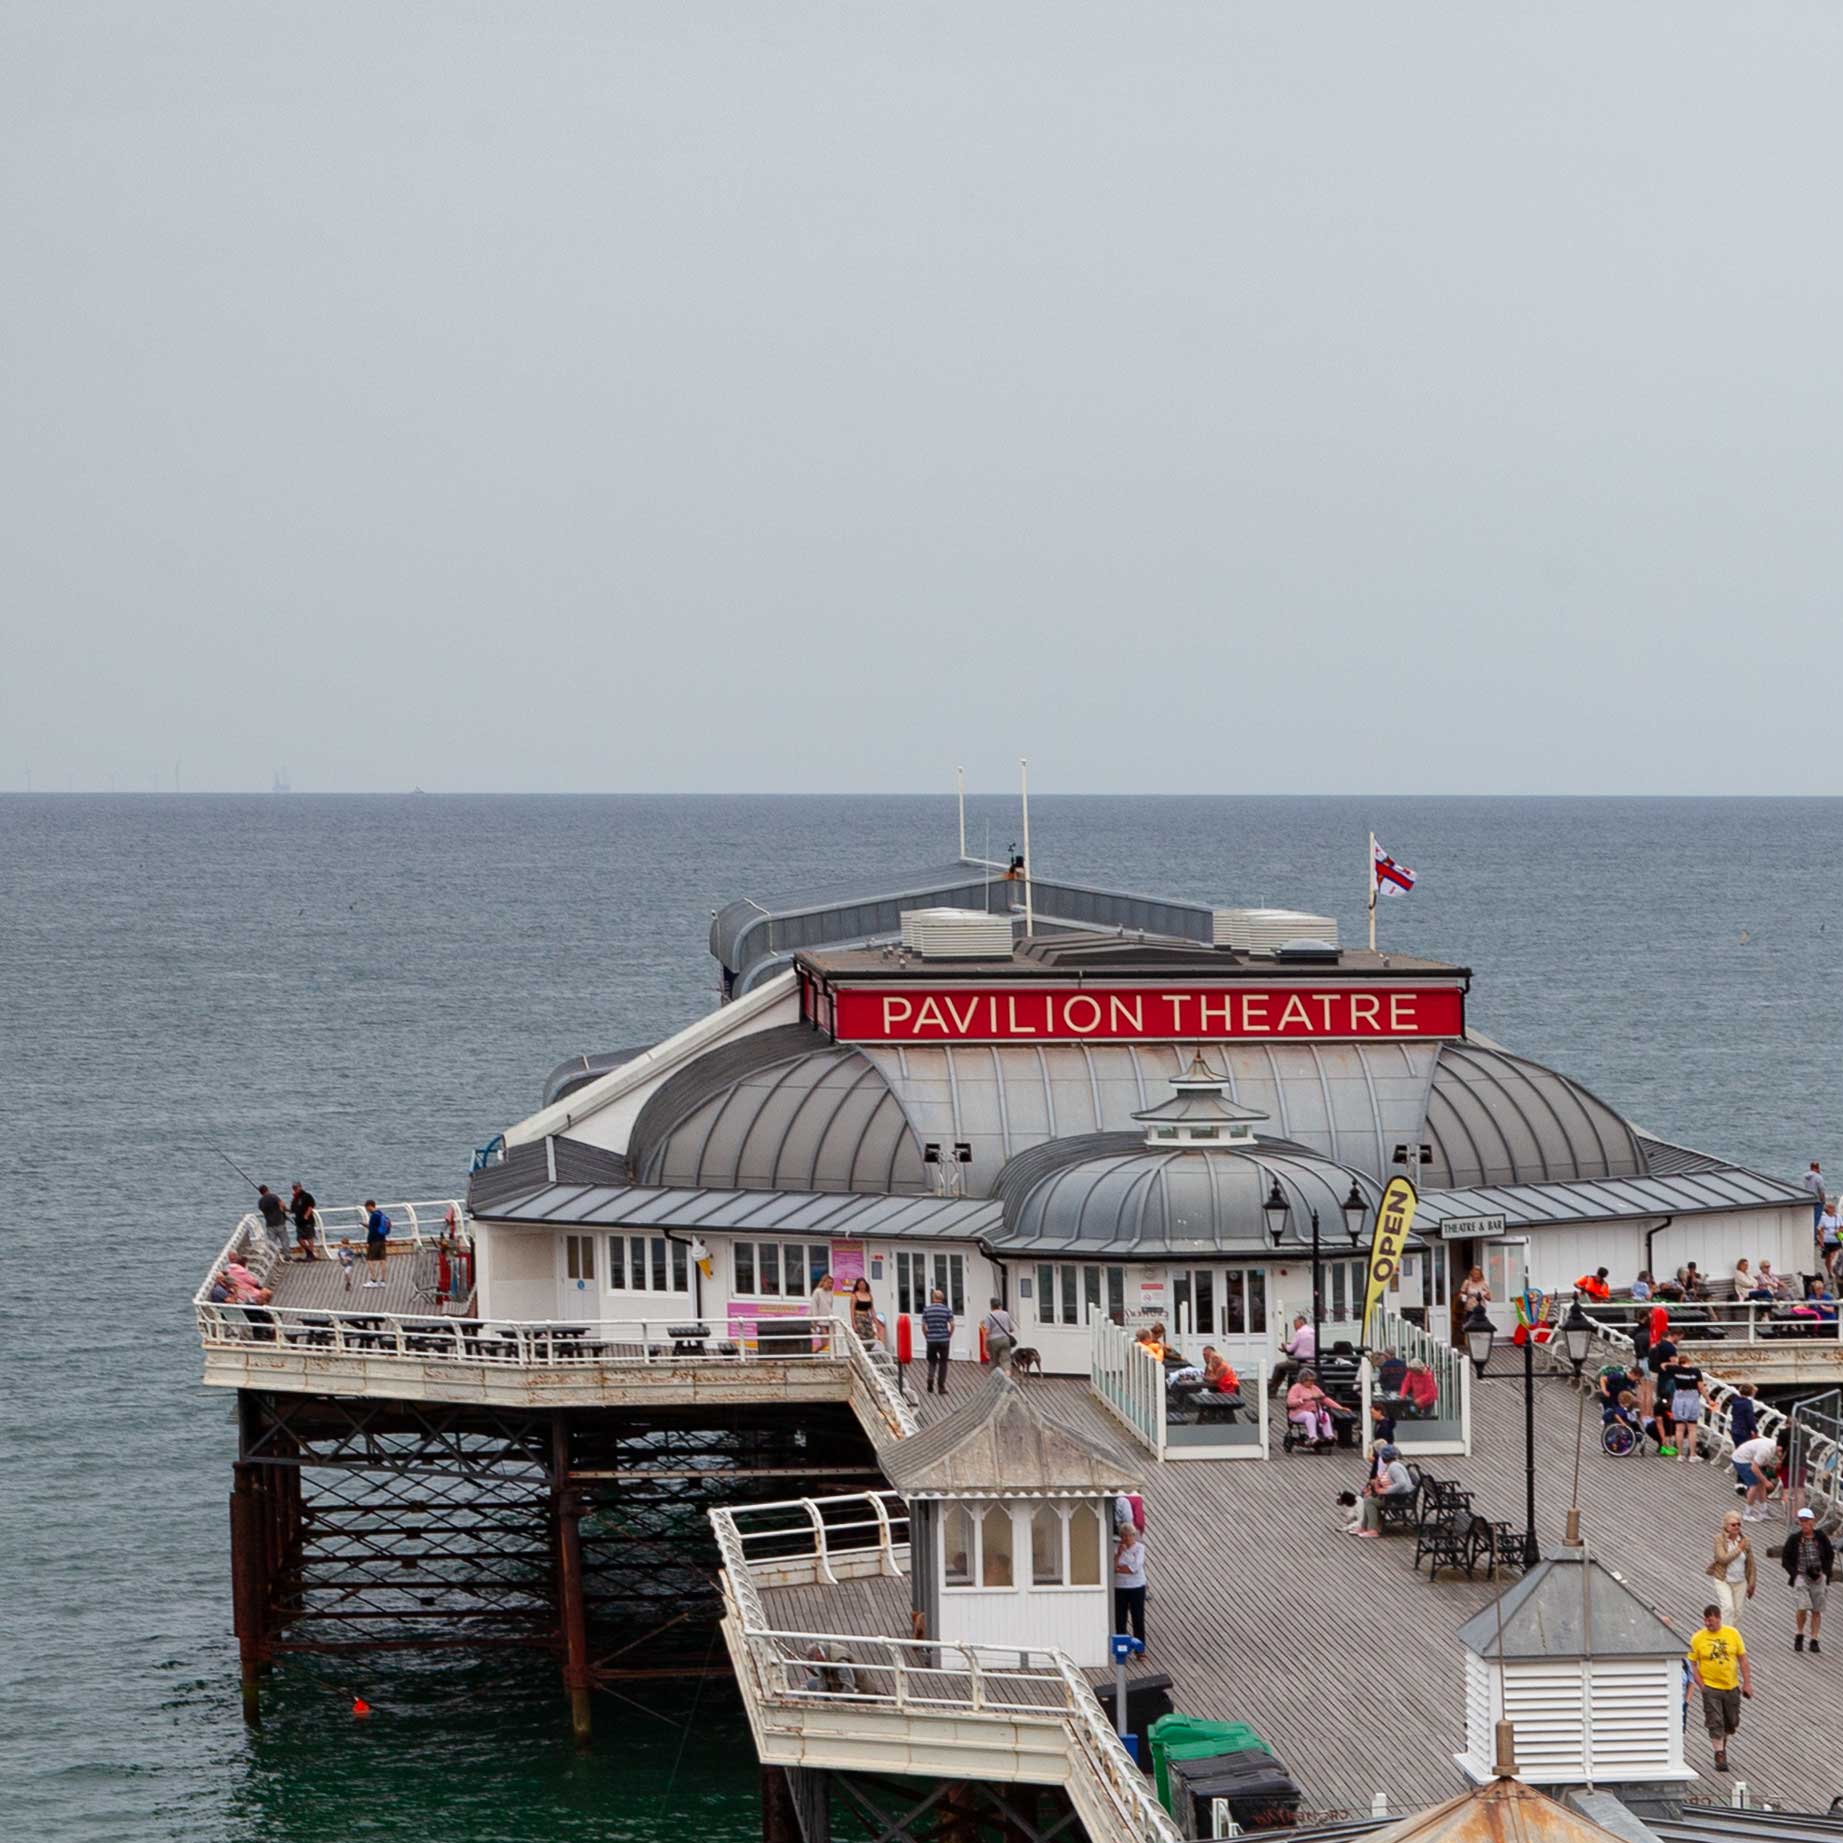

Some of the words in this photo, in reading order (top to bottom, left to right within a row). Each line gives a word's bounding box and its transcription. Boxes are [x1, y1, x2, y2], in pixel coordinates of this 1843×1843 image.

[883, 994, 1142, 1034] PAVILION
[1162, 993, 1418, 1031] THEATRE
[1373, 1189, 1408, 1282] OPEN
[1444, 1221, 1477, 1233] THEATRE
[1488, 1219, 1502, 1230] BAR
